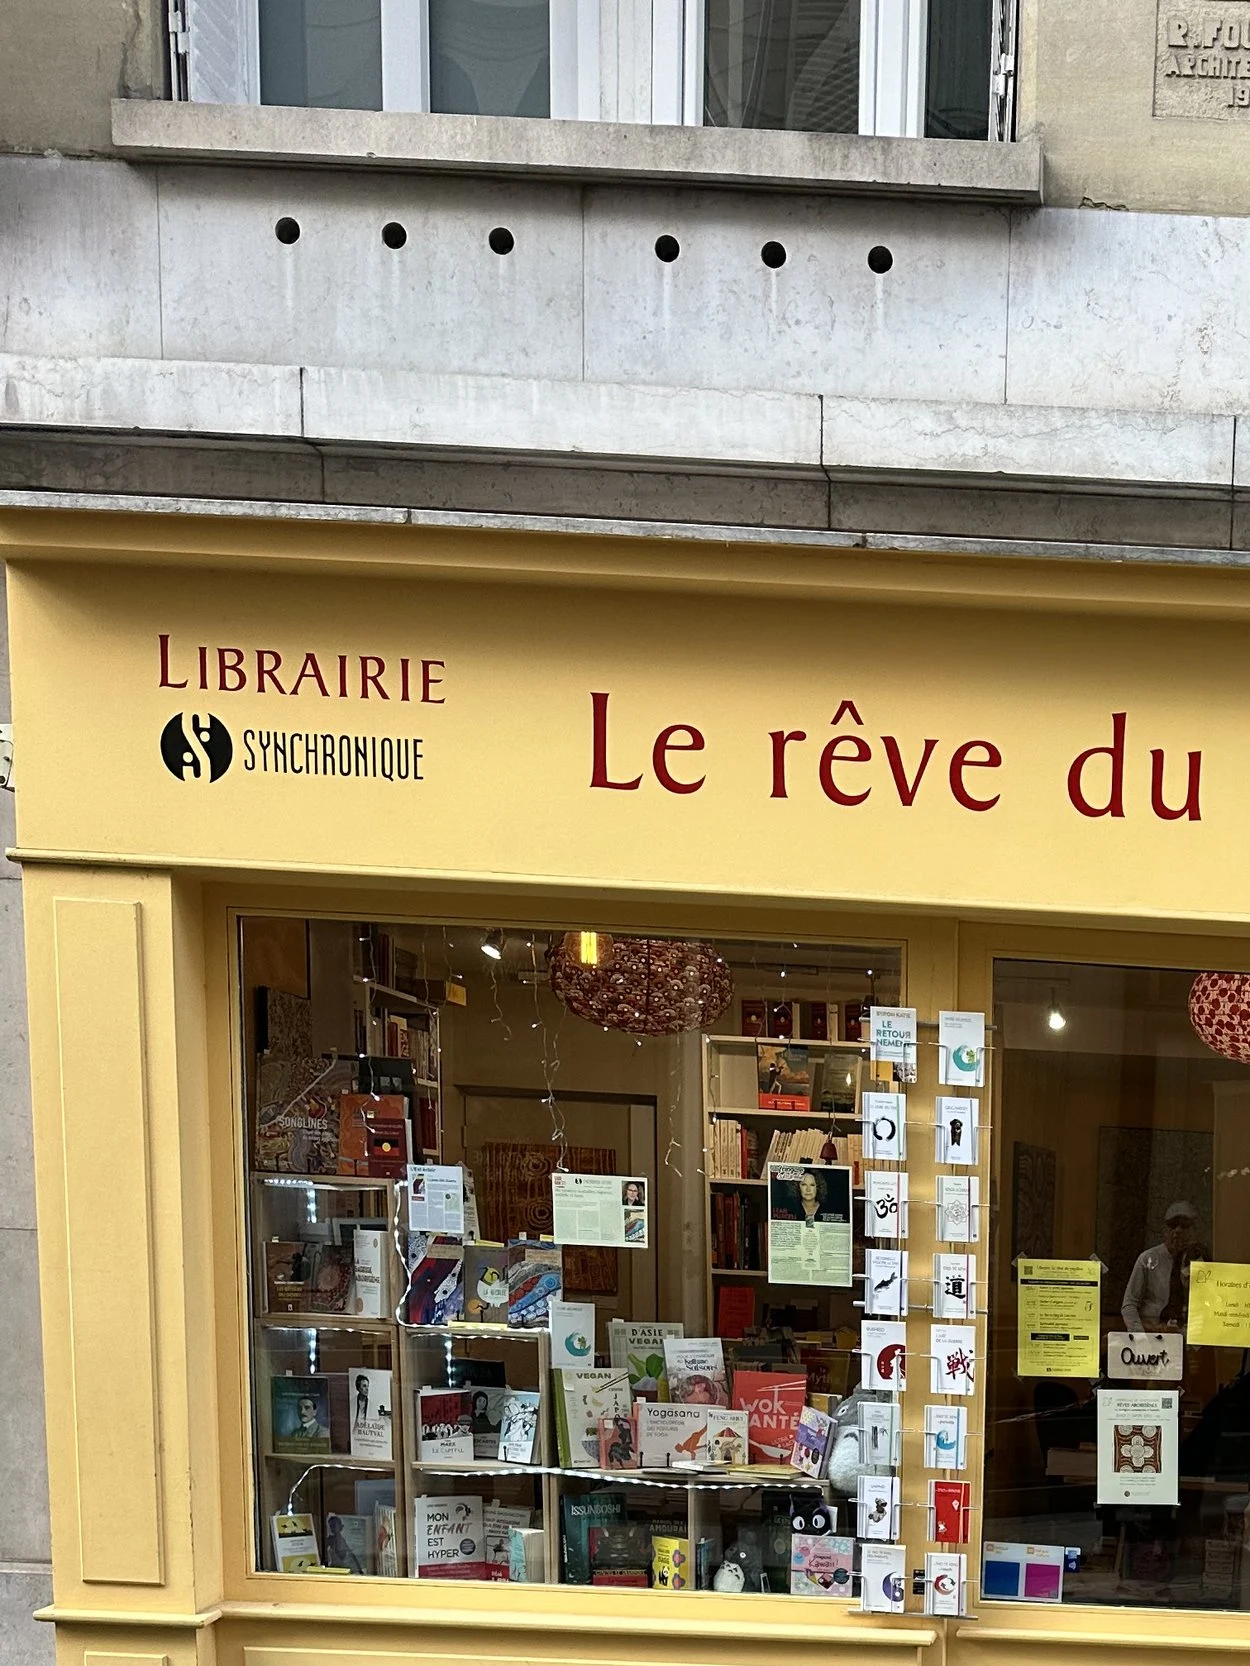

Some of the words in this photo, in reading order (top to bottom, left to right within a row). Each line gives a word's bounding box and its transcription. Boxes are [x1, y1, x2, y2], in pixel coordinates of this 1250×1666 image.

[243, 729, 424, 782] SYNCHRONIQUE
[589, 692, 706, 794] Le
[768, 700, 1002, 812] rêve
[1067, 711, 1202, 821] du
[882, 1020, 893, 1028] LE
[278, 1116, 328, 1130] SONGLINES
[631, 1329, 664, 1337] D'ASIE
[1121, 1347, 1169, 1366] Ouvert
[740, 1390, 786, 1414] WOK
[647, 1407, 700, 1418] Yogasana
[749, 1412, 800, 1430] ANTÉ
[427, 1513, 448, 1522] MON
[427, 1523, 473, 1535] ENFANT
[428, 1538, 444, 1547] EST
[428, 1549, 459, 1558] HYPER
